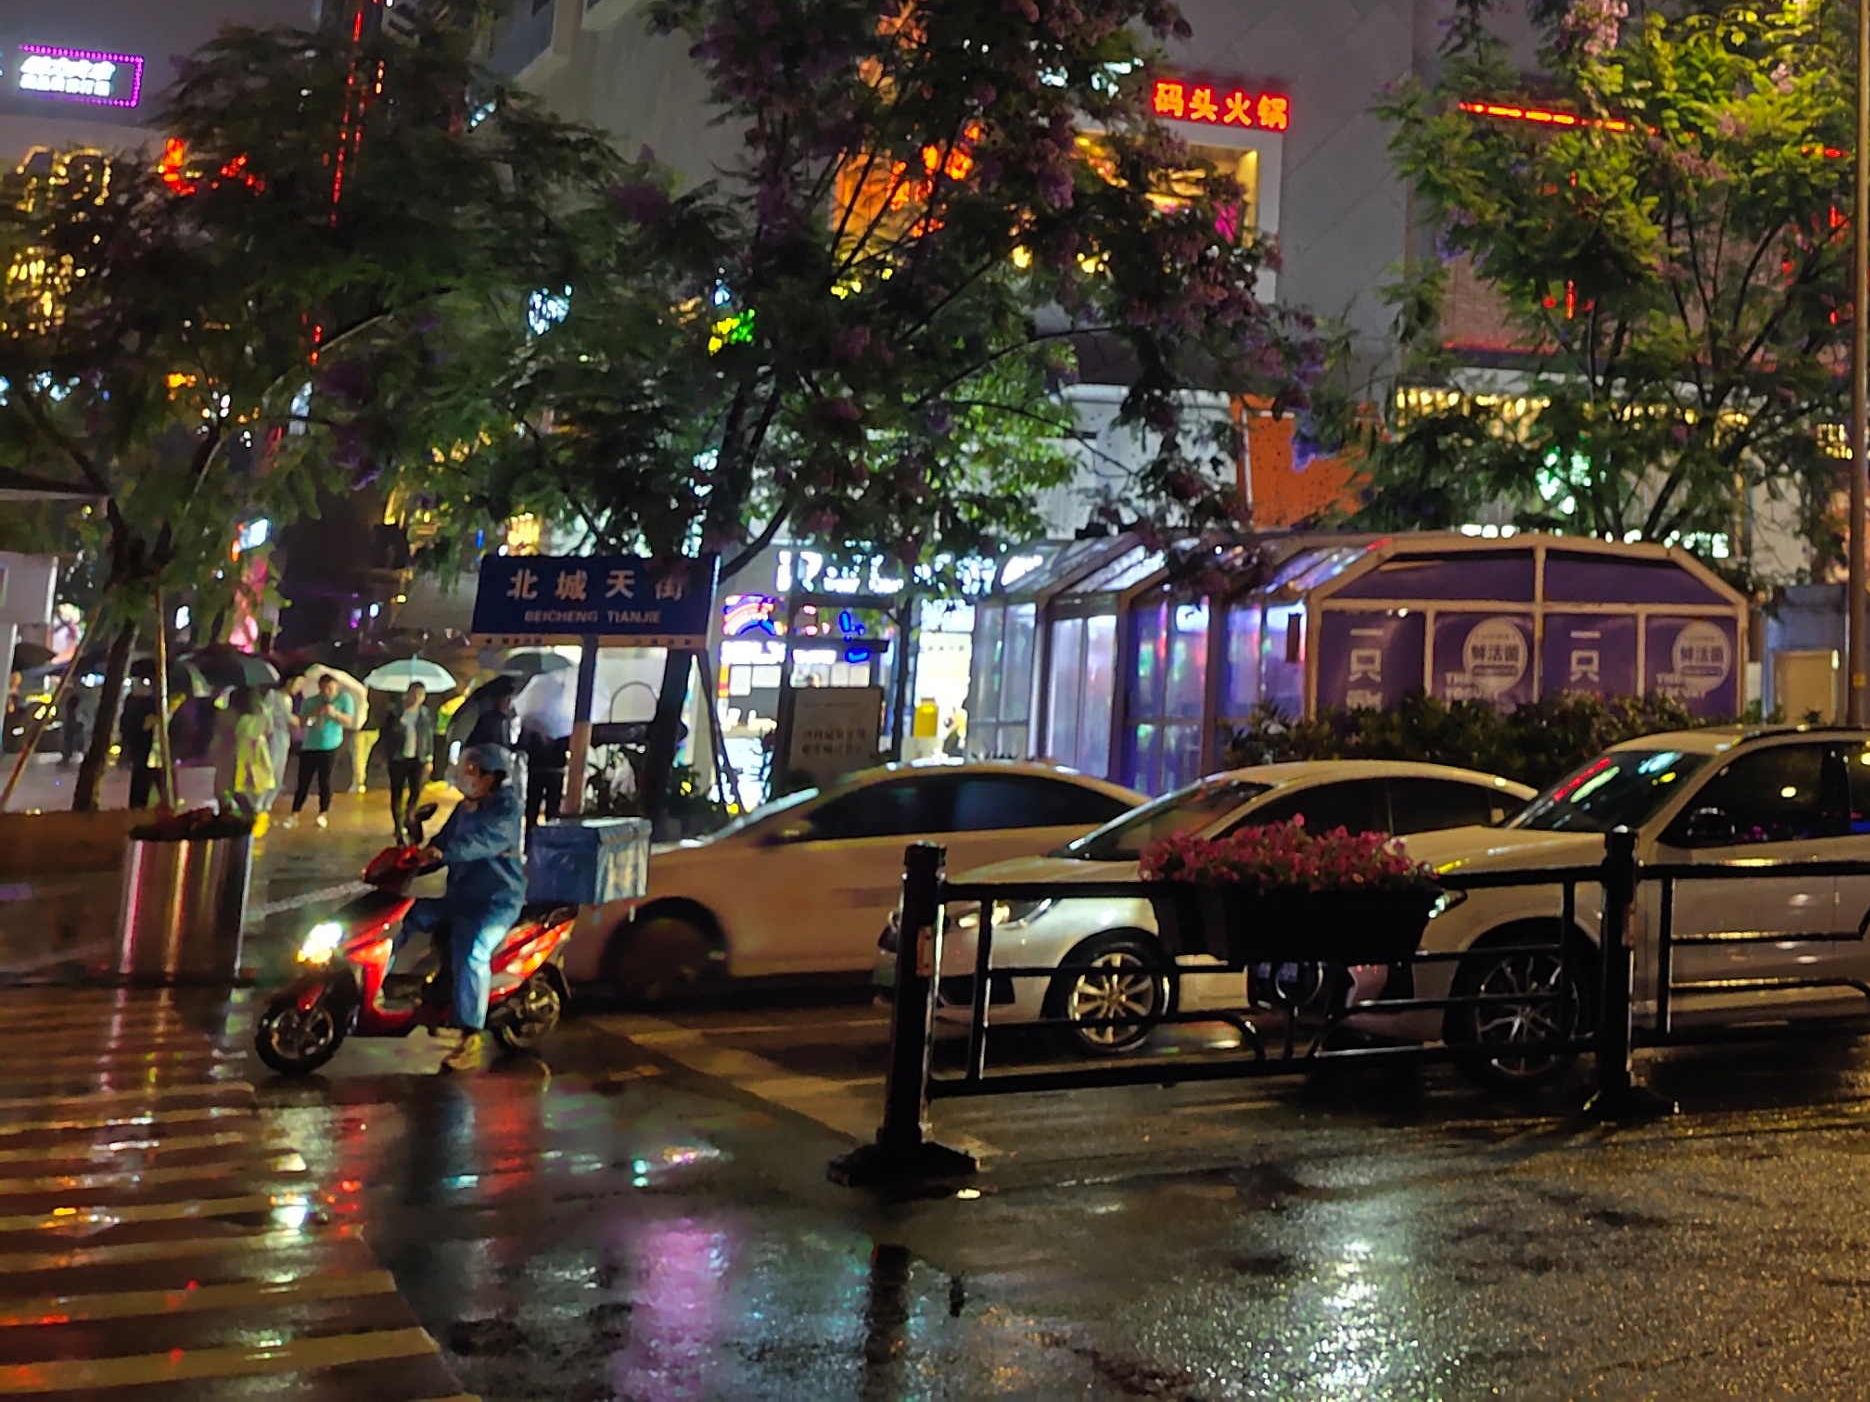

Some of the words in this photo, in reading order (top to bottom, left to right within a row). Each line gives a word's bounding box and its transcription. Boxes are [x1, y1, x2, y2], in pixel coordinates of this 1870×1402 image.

[1154, 82, 1289, 131] 码头火锅
[525, 609, 598, 623] BEICHENG
[607, 609, 661, 624] TIANJIE
